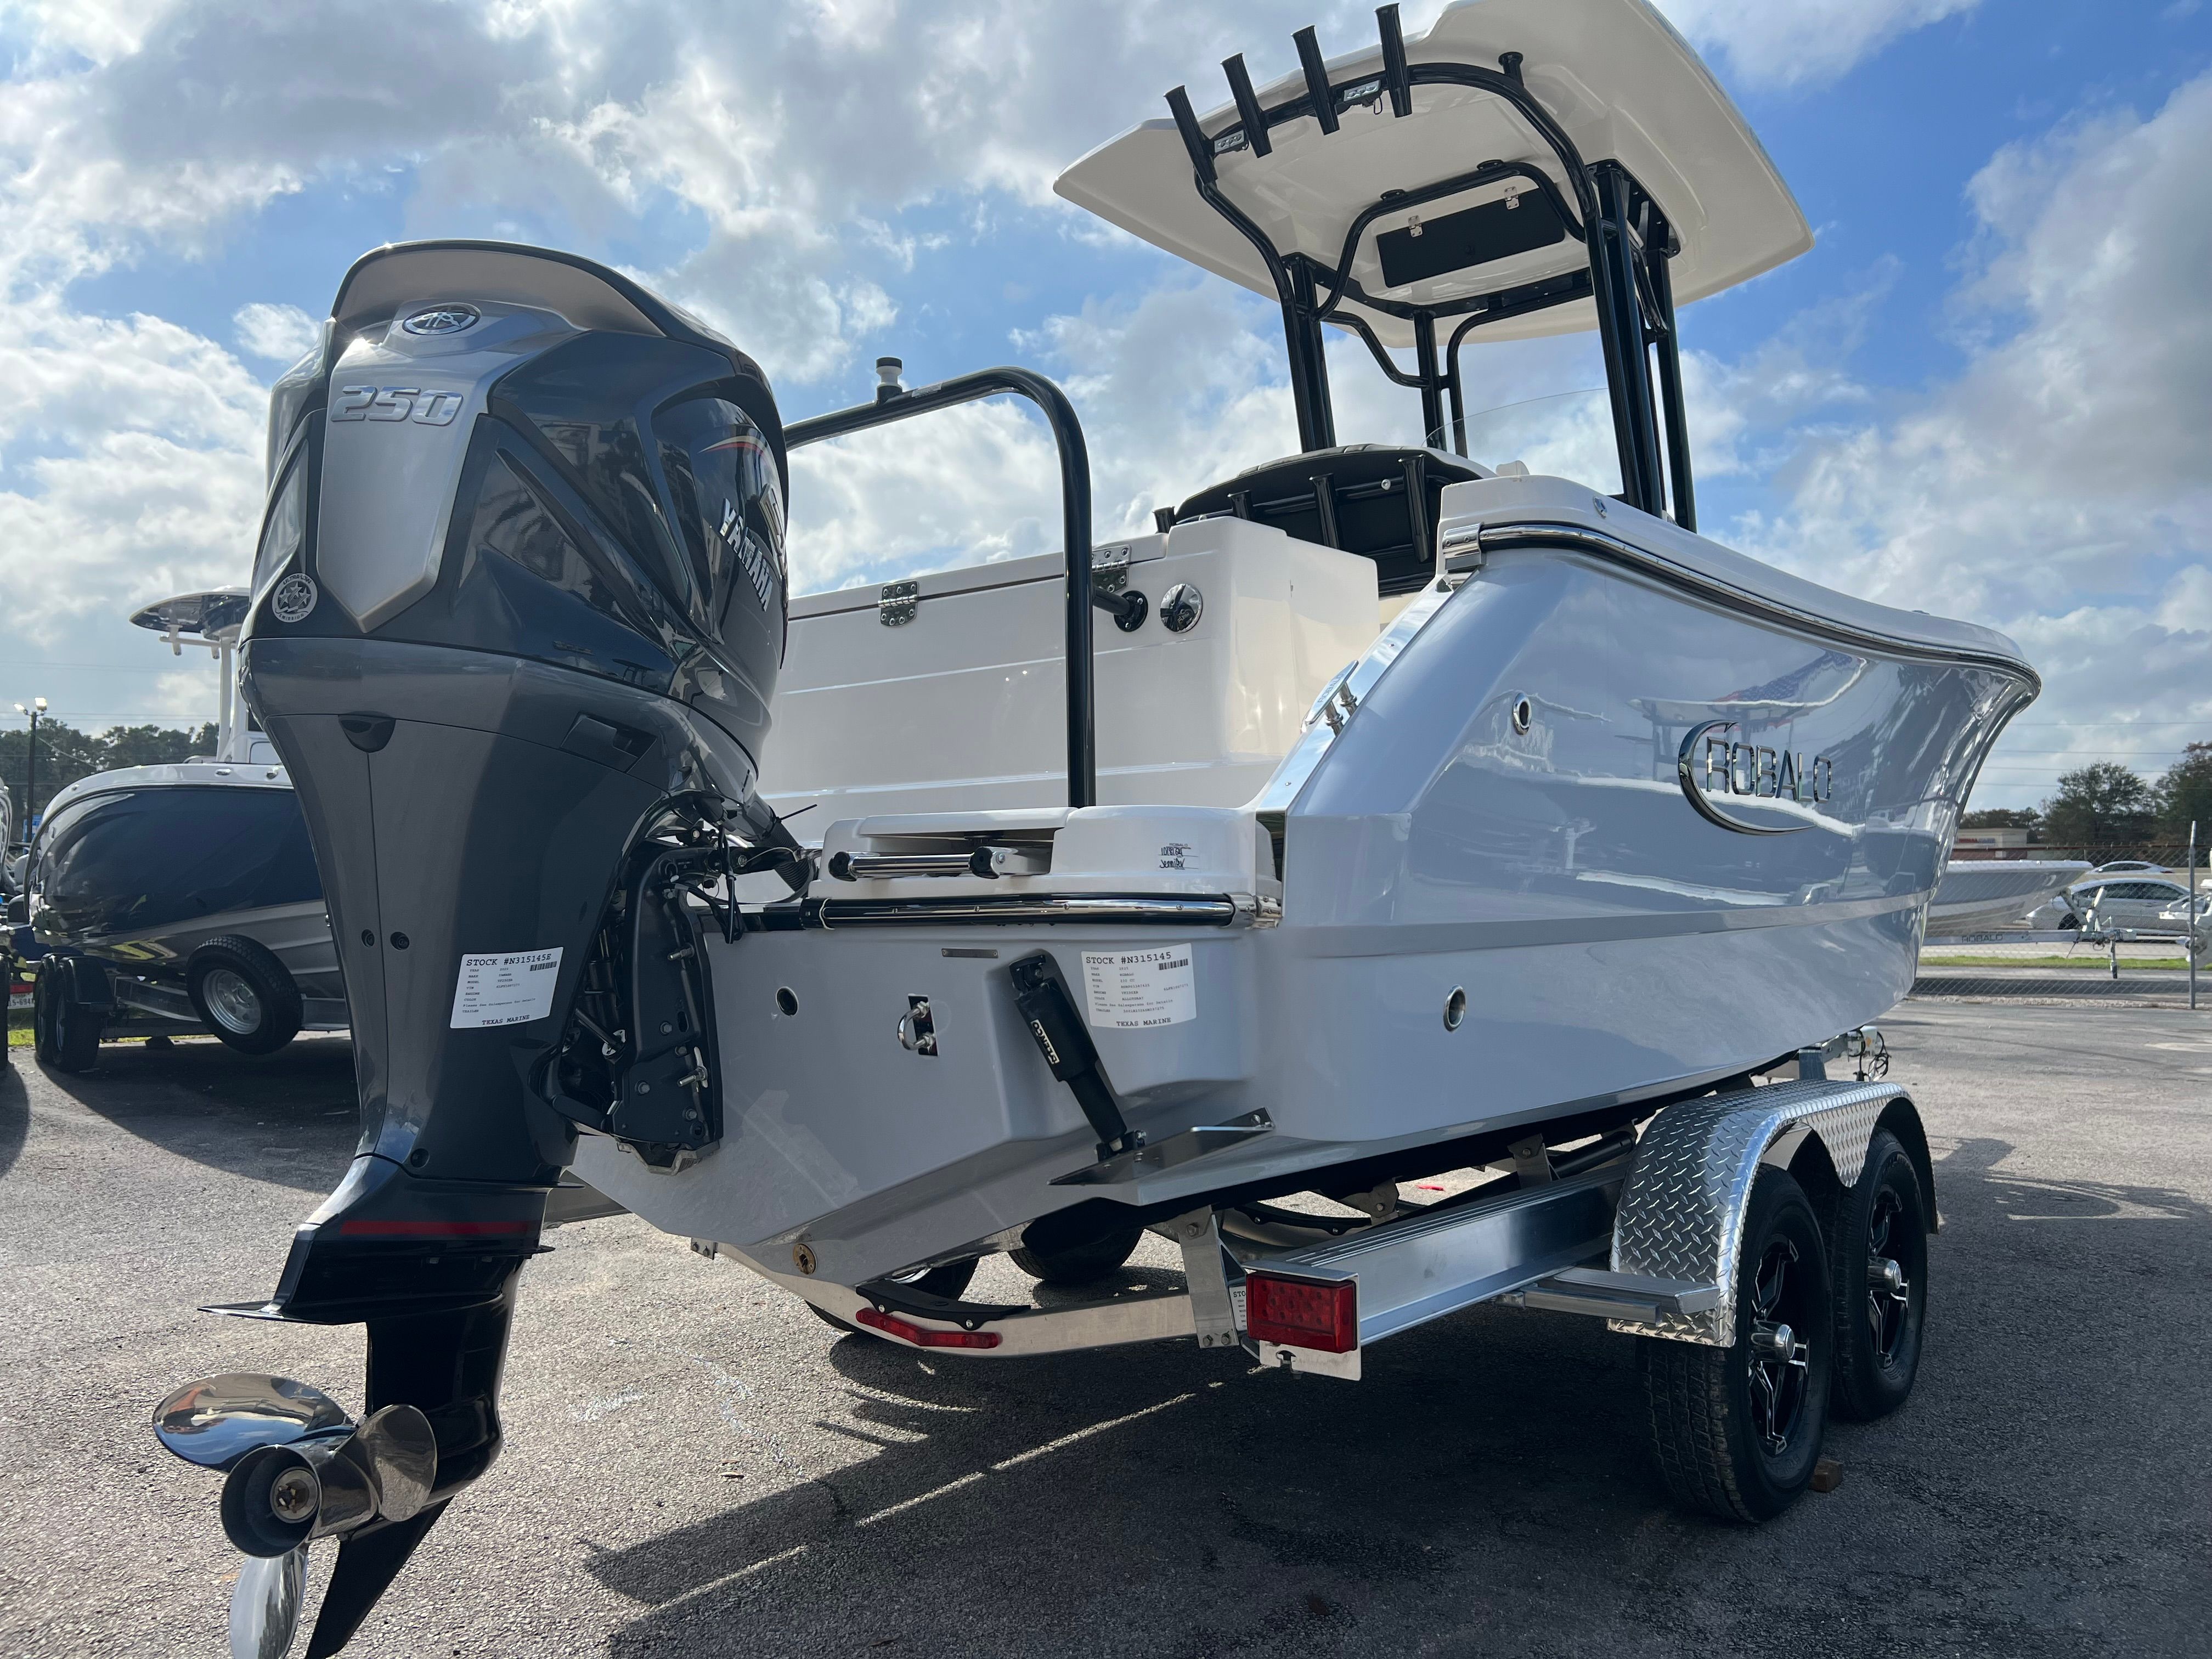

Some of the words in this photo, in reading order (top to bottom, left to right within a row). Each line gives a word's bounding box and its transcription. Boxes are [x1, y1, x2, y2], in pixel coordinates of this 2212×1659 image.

[330, 386, 463, 426] 250
[719, 498, 773, 612] YAMAHA
[1318, 673, 1344, 703] ROBALO
[1706, 736, 1831, 803] ROBALO
[1962, 934, 2003, 943] ROBALO
[504, 953, 551, 965] #N315145E
[1121, 952, 1171, 964] #N315145
[506, 1014, 530, 1023] MARINE
[1143, 1017, 1171, 1026] MARINE
